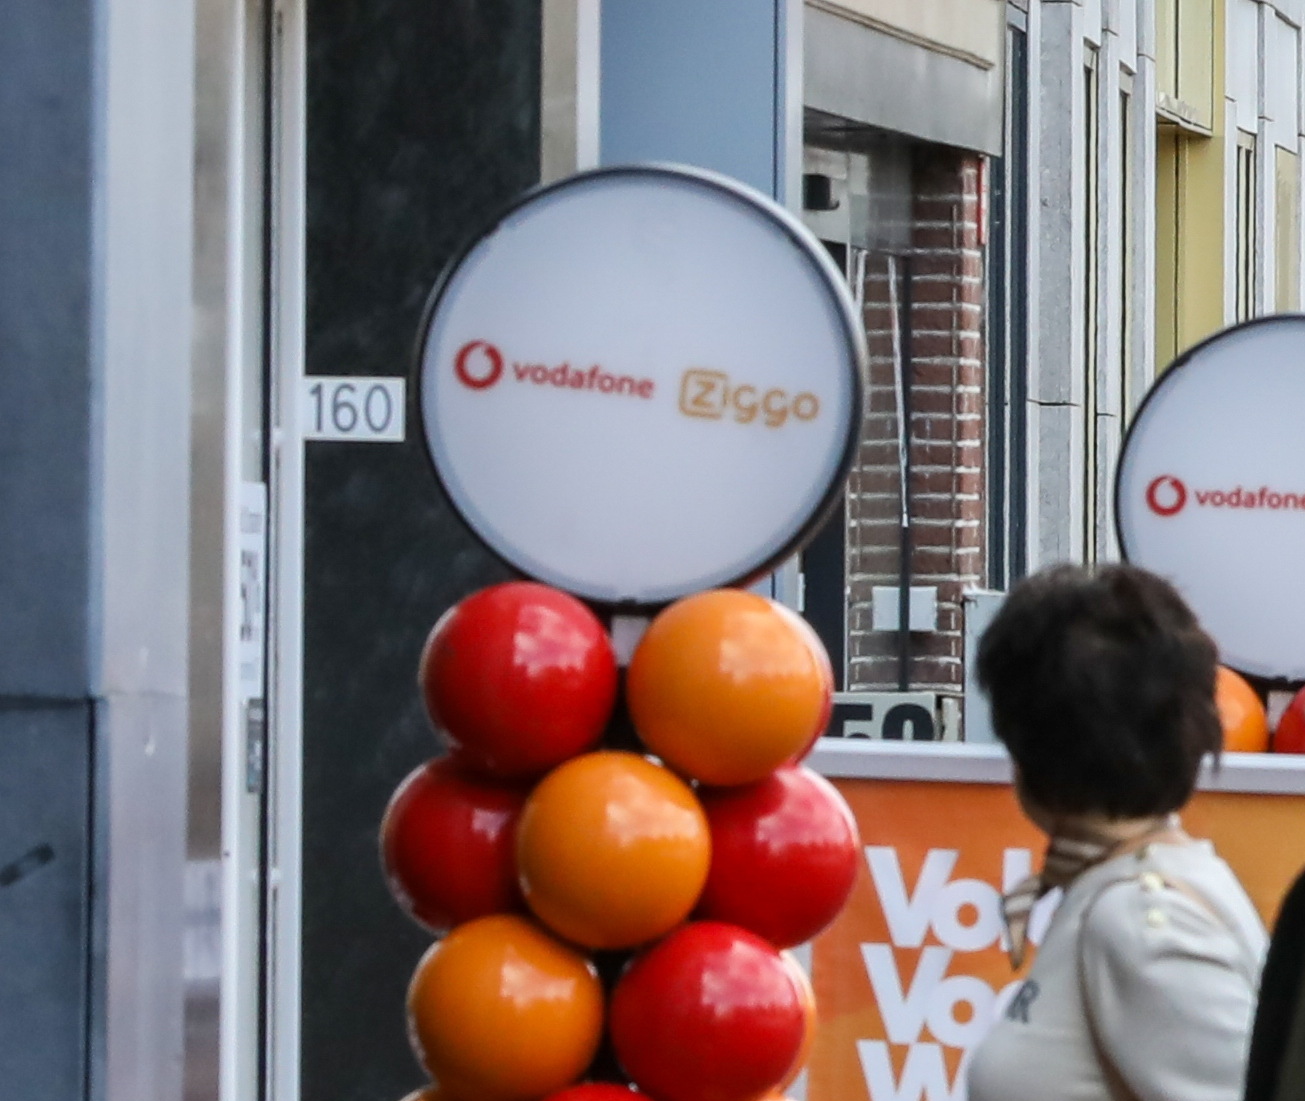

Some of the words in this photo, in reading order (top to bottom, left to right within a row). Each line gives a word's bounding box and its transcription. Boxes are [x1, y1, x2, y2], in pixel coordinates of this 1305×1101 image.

[308, 383, 394, 433] 160
[512, 362, 655, 399] vodafone
[679, 367, 821, 428] Ziggo
